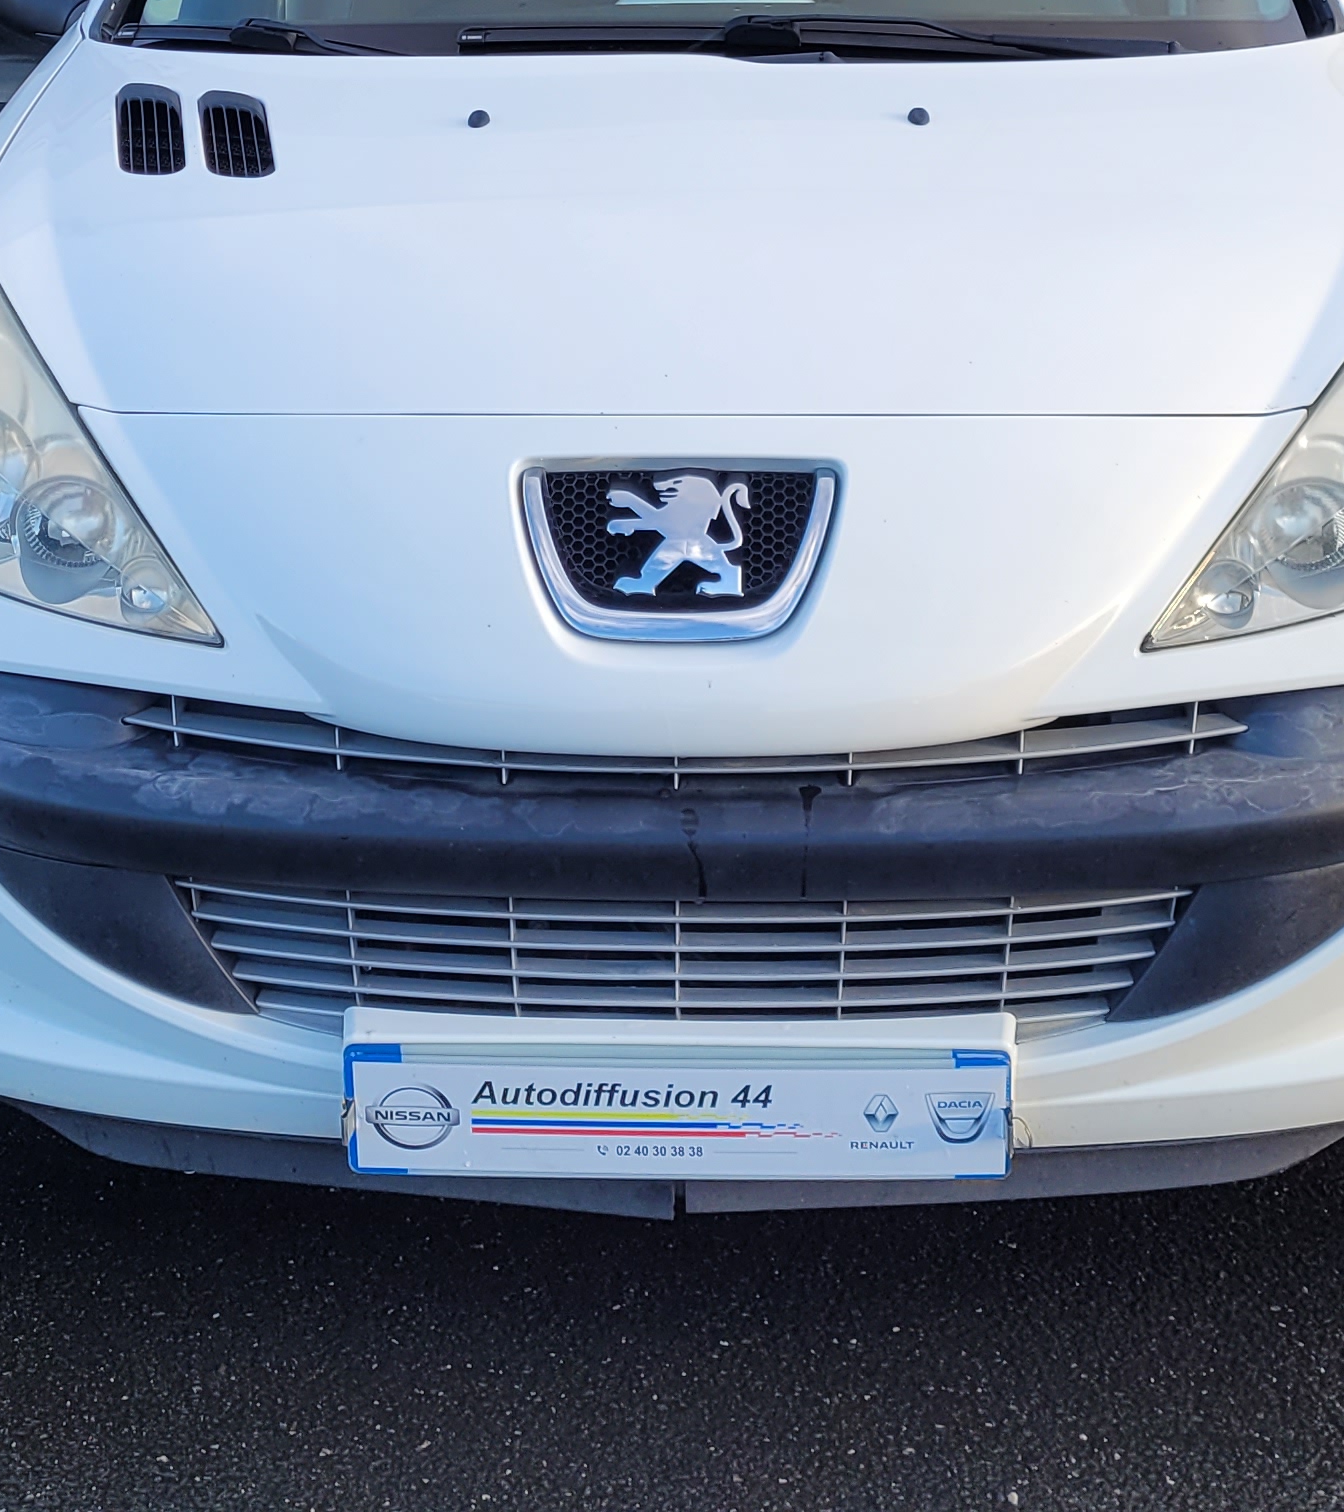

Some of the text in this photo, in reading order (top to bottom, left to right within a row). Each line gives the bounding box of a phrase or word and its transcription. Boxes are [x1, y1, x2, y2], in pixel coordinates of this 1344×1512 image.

[470, 1080, 774, 1109] Autodiffusion 44
[937, 1100, 983, 1109] DACIA
[374, 1109, 452, 1123] NISSAN
[616, 1145, 703, 1157] 02 40 30 38 38
[850, 1140, 915, 1150] RENAULT
